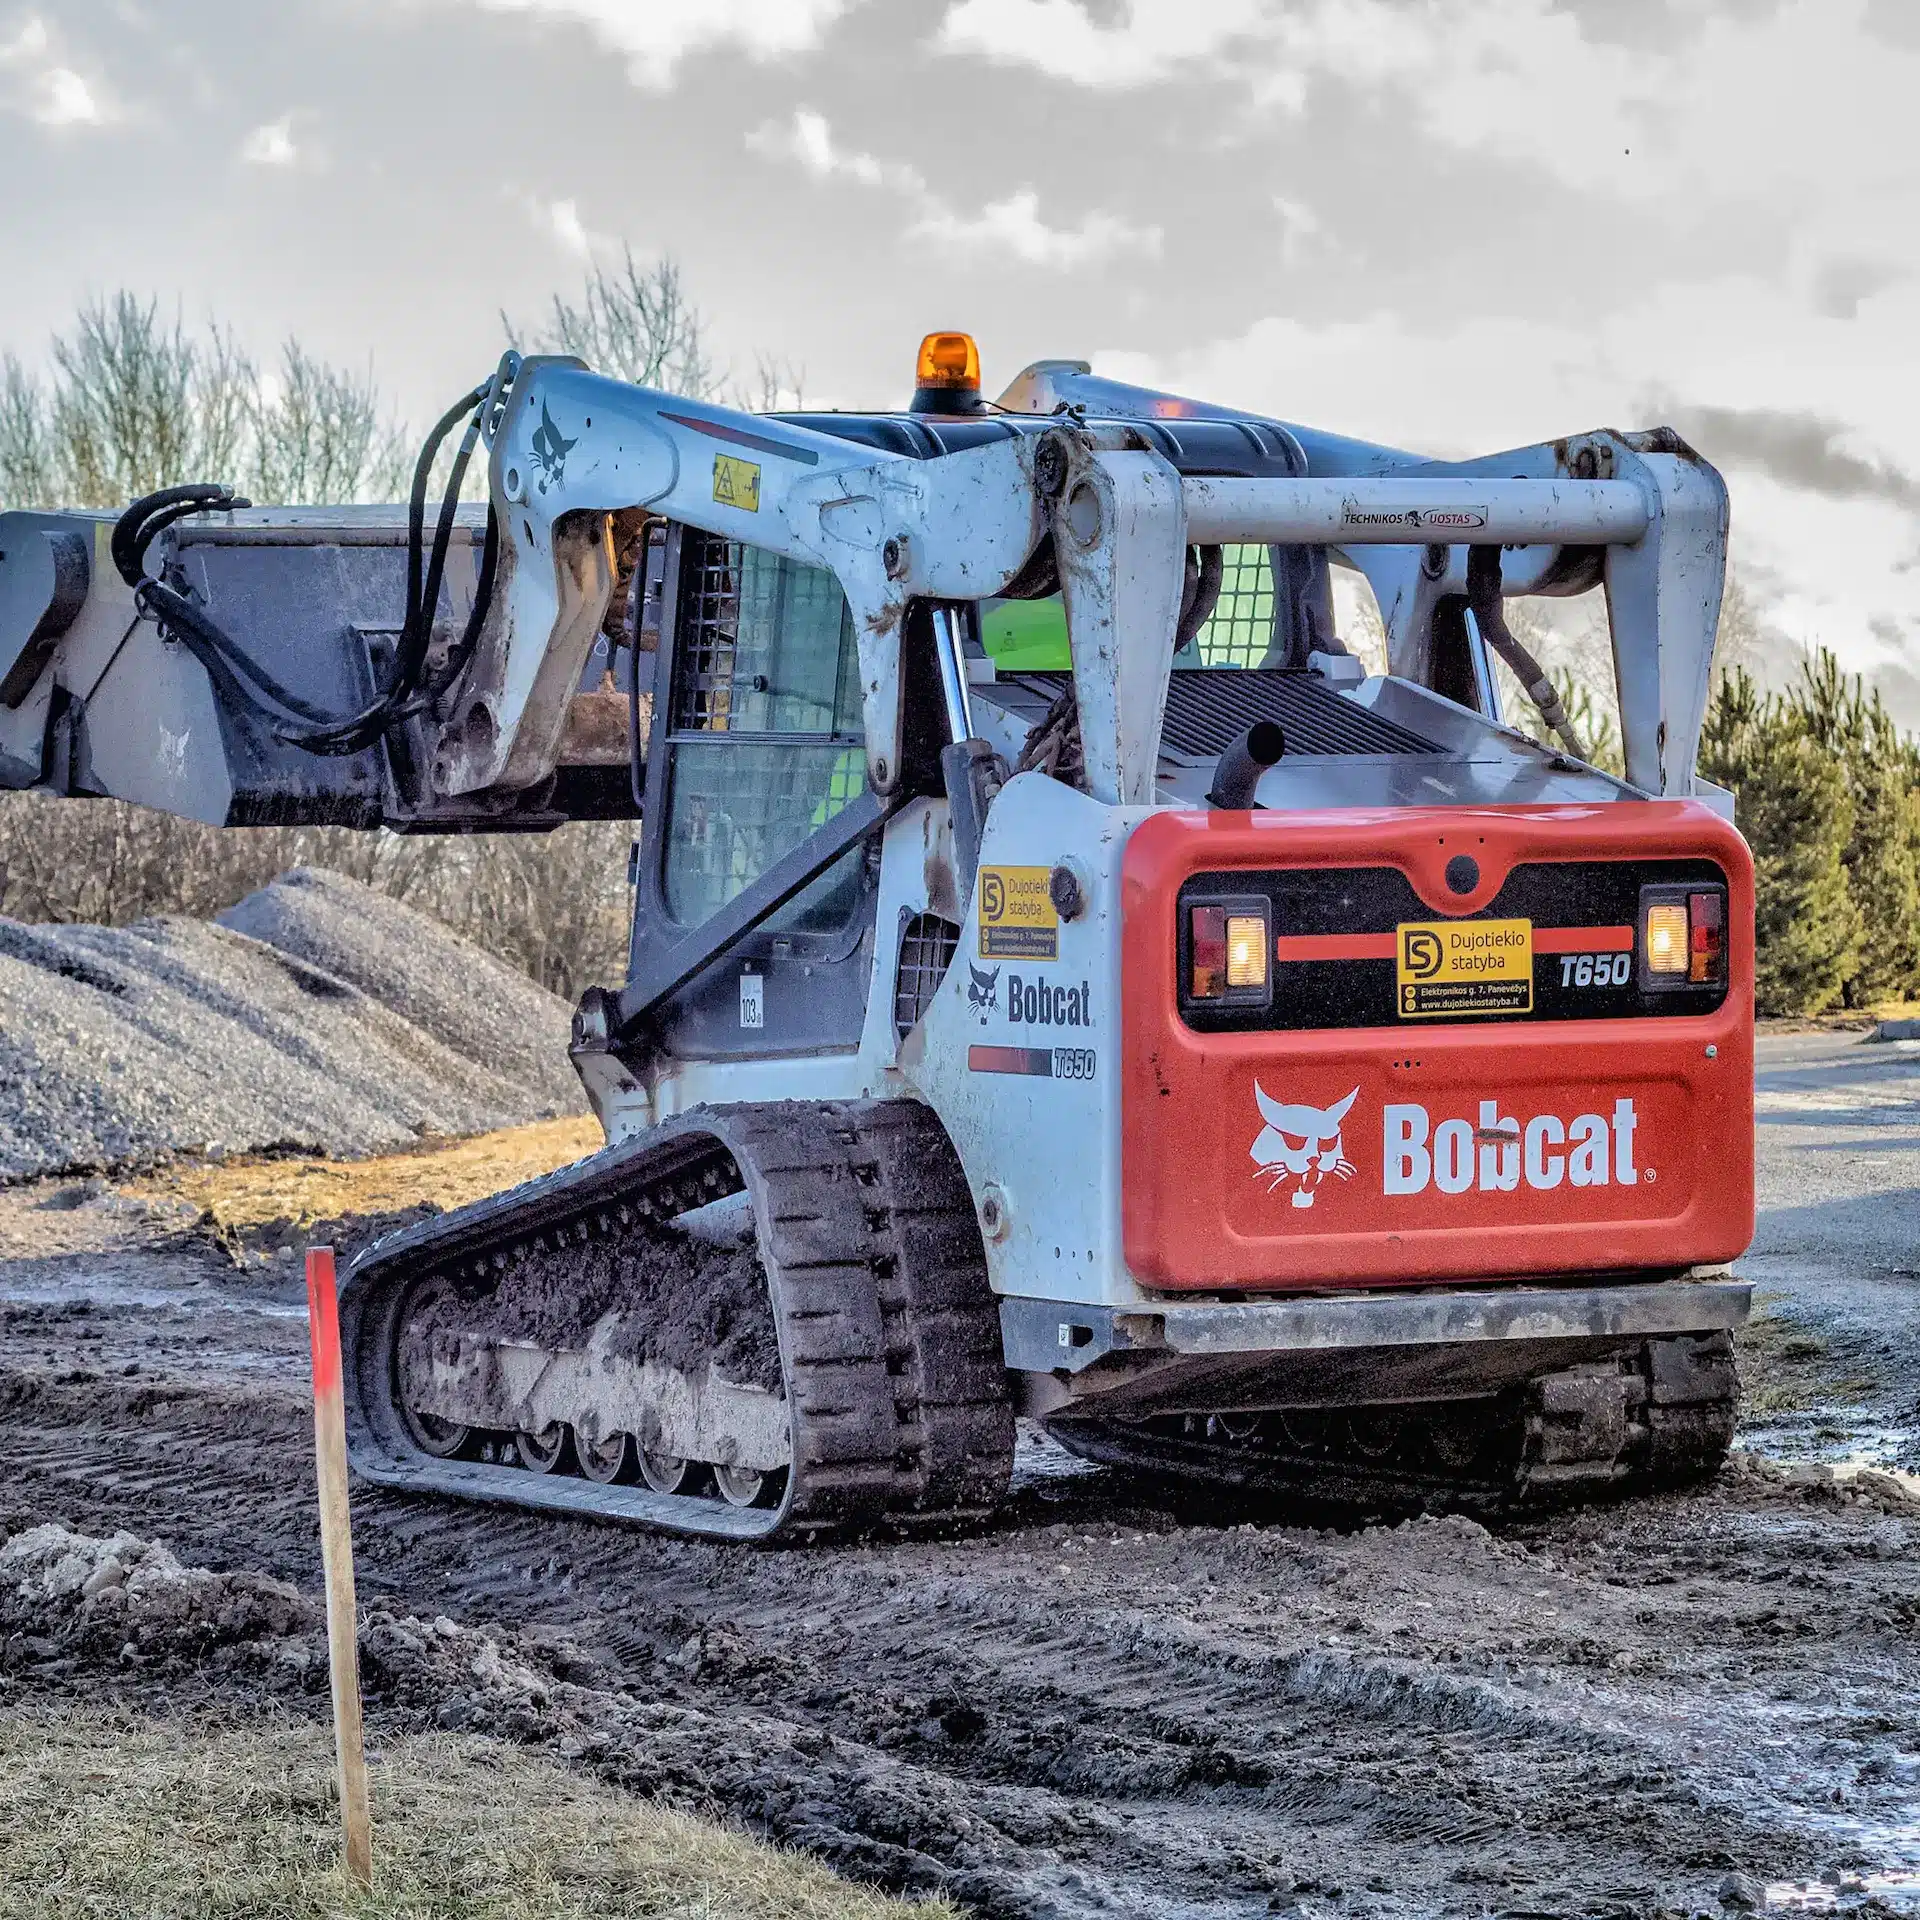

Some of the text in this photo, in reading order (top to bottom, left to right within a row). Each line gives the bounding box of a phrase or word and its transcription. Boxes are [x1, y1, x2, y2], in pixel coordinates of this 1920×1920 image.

[1344, 513, 1470, 524] TECHNIKOS UOSTAS
[1008, 878, 1049, 897] Dujotieki
[1009, 899, 1042, 918] statyba
[1450, 930, 1525, 951] Dujotiekio
[1451, 953, 1505, 972] statyba
[1560, 953, 1631, 987] T650
[1008, 975, 1090, 1027] Bobcat
[1421, 986, 1467, 997] Elektronikos
[742, 998, 756, 1023] 103
[1421, 996, 1520, 1010] www.dujotiekiostatyba.lt
[1054, 1047, 1097, 1080] T650
[1383, 1098, 1638, 1196] Bobcat
